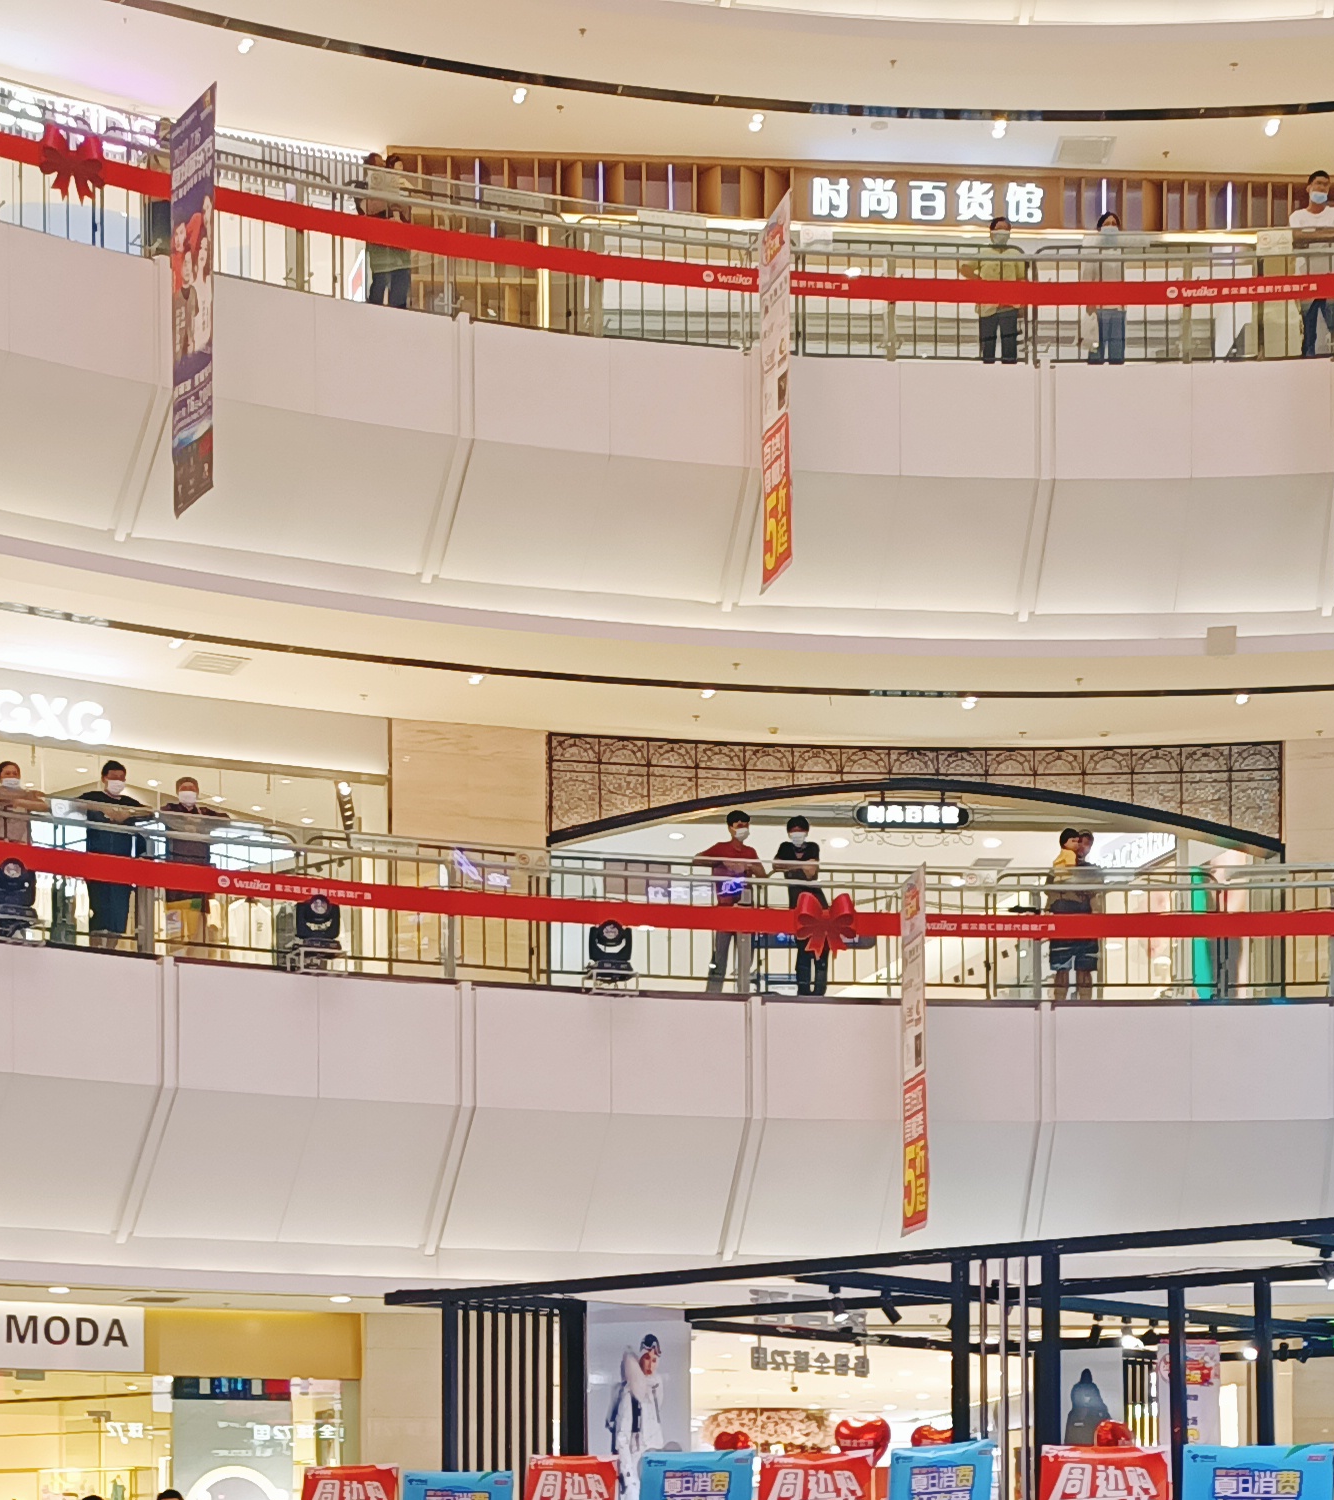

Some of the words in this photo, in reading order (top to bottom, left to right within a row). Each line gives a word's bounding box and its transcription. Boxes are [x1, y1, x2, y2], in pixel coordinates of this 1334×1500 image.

[812, 176, 1045, 223] 时尚百货馆
[765, 491, 777, 570] 5
[904, 1144, 916, 1218] 5
[5, 1314, 129, 1348] MODA
[664, 1472, 730, 1493] 夏日消费
[910, 1466, 974, 1492] 夏日消费
[1214, 1470, 1302, 1496] 夏日消费
